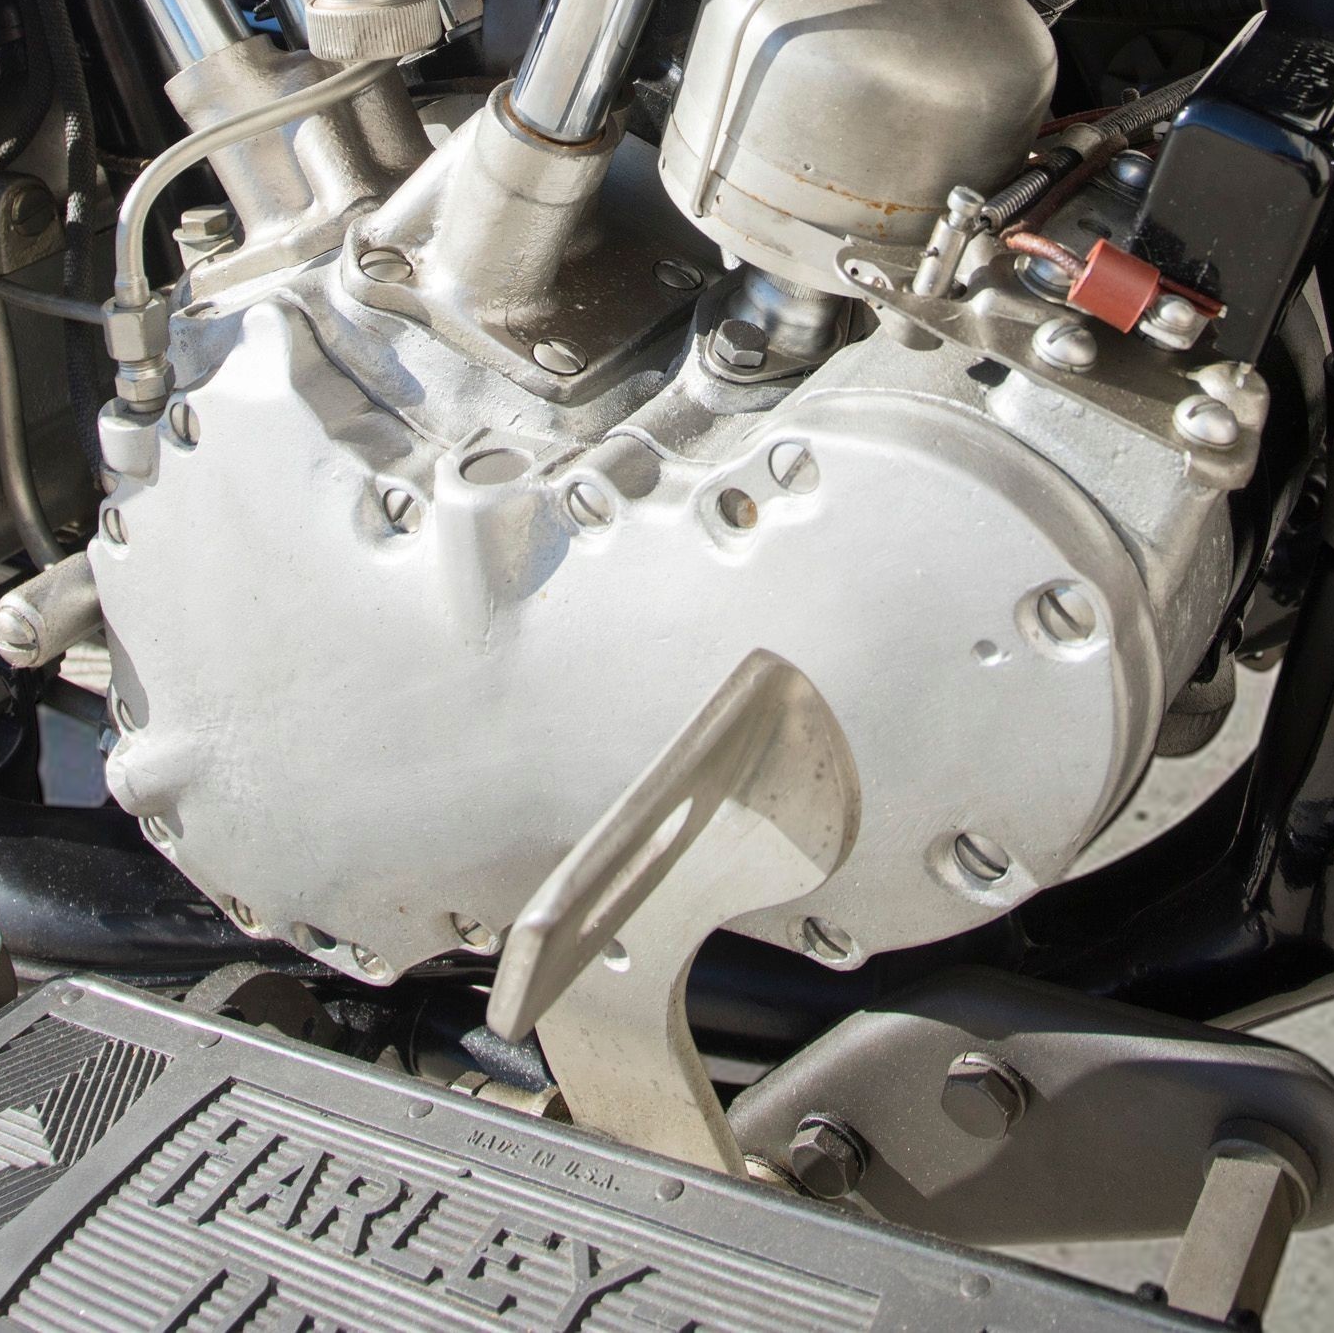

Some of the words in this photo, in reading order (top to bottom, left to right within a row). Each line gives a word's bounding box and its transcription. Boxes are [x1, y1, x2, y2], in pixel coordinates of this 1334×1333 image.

[147, 1114, 661, 1332] HARLEY
[467, 1129, 526, 1159] MADE
[529, 1148, 557, 1169] IN
[564, 1159, 621, 1192] U.S.A.
